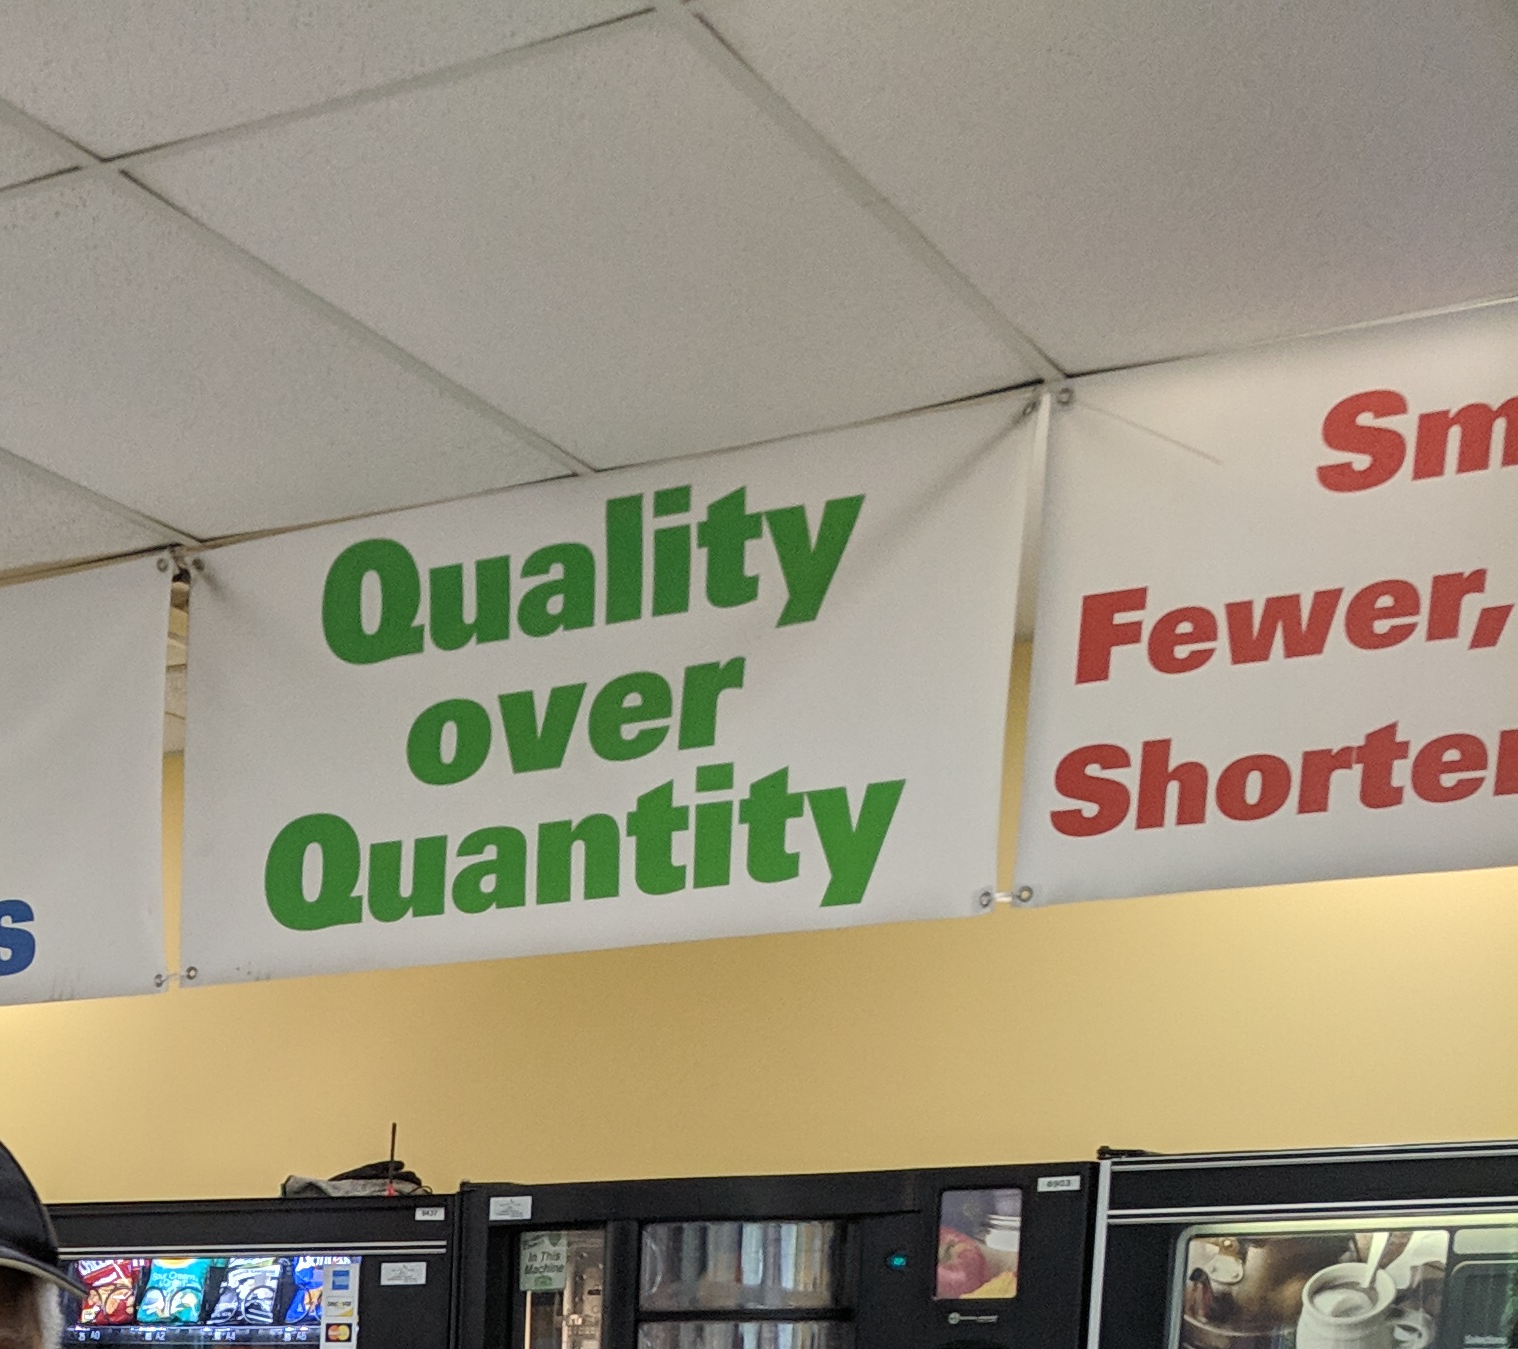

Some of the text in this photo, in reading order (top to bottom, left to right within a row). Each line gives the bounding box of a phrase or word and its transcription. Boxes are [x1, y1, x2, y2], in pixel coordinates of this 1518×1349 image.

[321, 485, 865, 665] Quality
[1075, 568, 1516, 685] Fewer,
[406, 656, 746, 786] over
[264, 761, 905, 931] Quantity
[524, 1263, 565, 1275] Machine
[528, 1250, 561, 1262] In This
